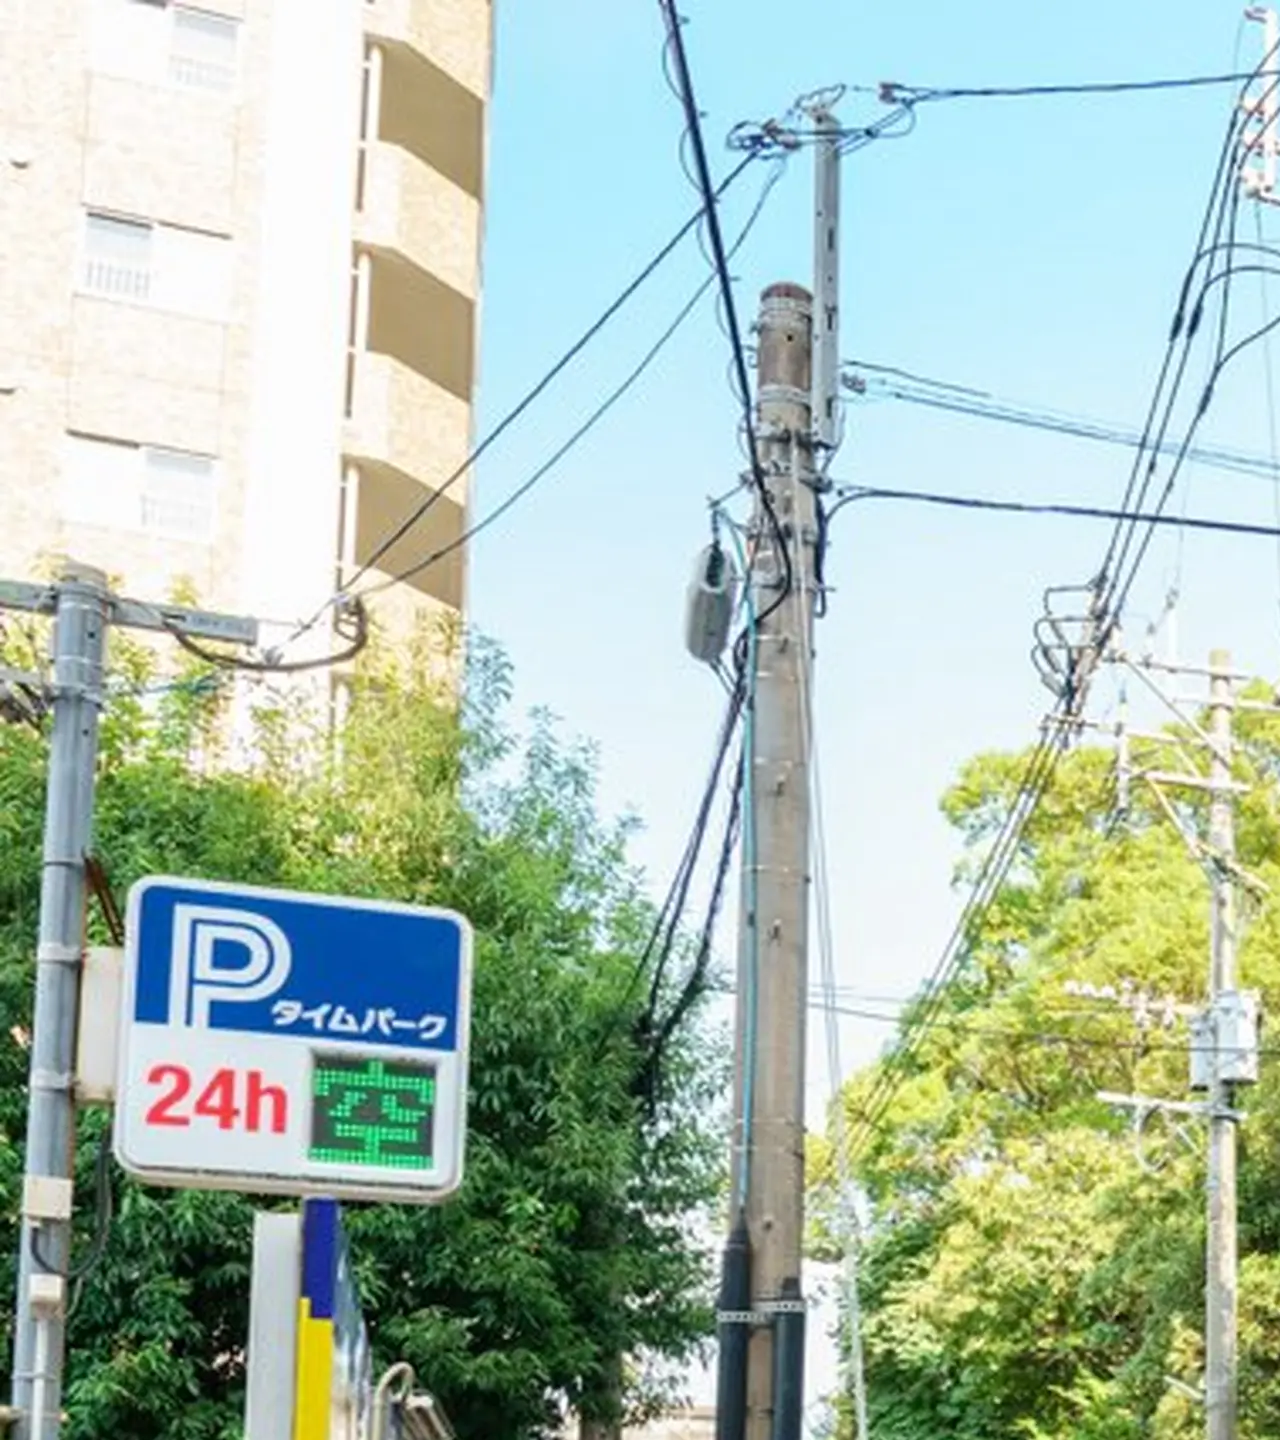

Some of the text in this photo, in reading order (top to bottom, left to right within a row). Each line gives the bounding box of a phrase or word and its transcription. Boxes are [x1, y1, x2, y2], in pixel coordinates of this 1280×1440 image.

[168, 903, 292, 1028] P
[271, 998, 448, 1040] タイムパーク
[144, 1063, 288, 1135] 24h
[306, 1059, 436, 1171] 空
